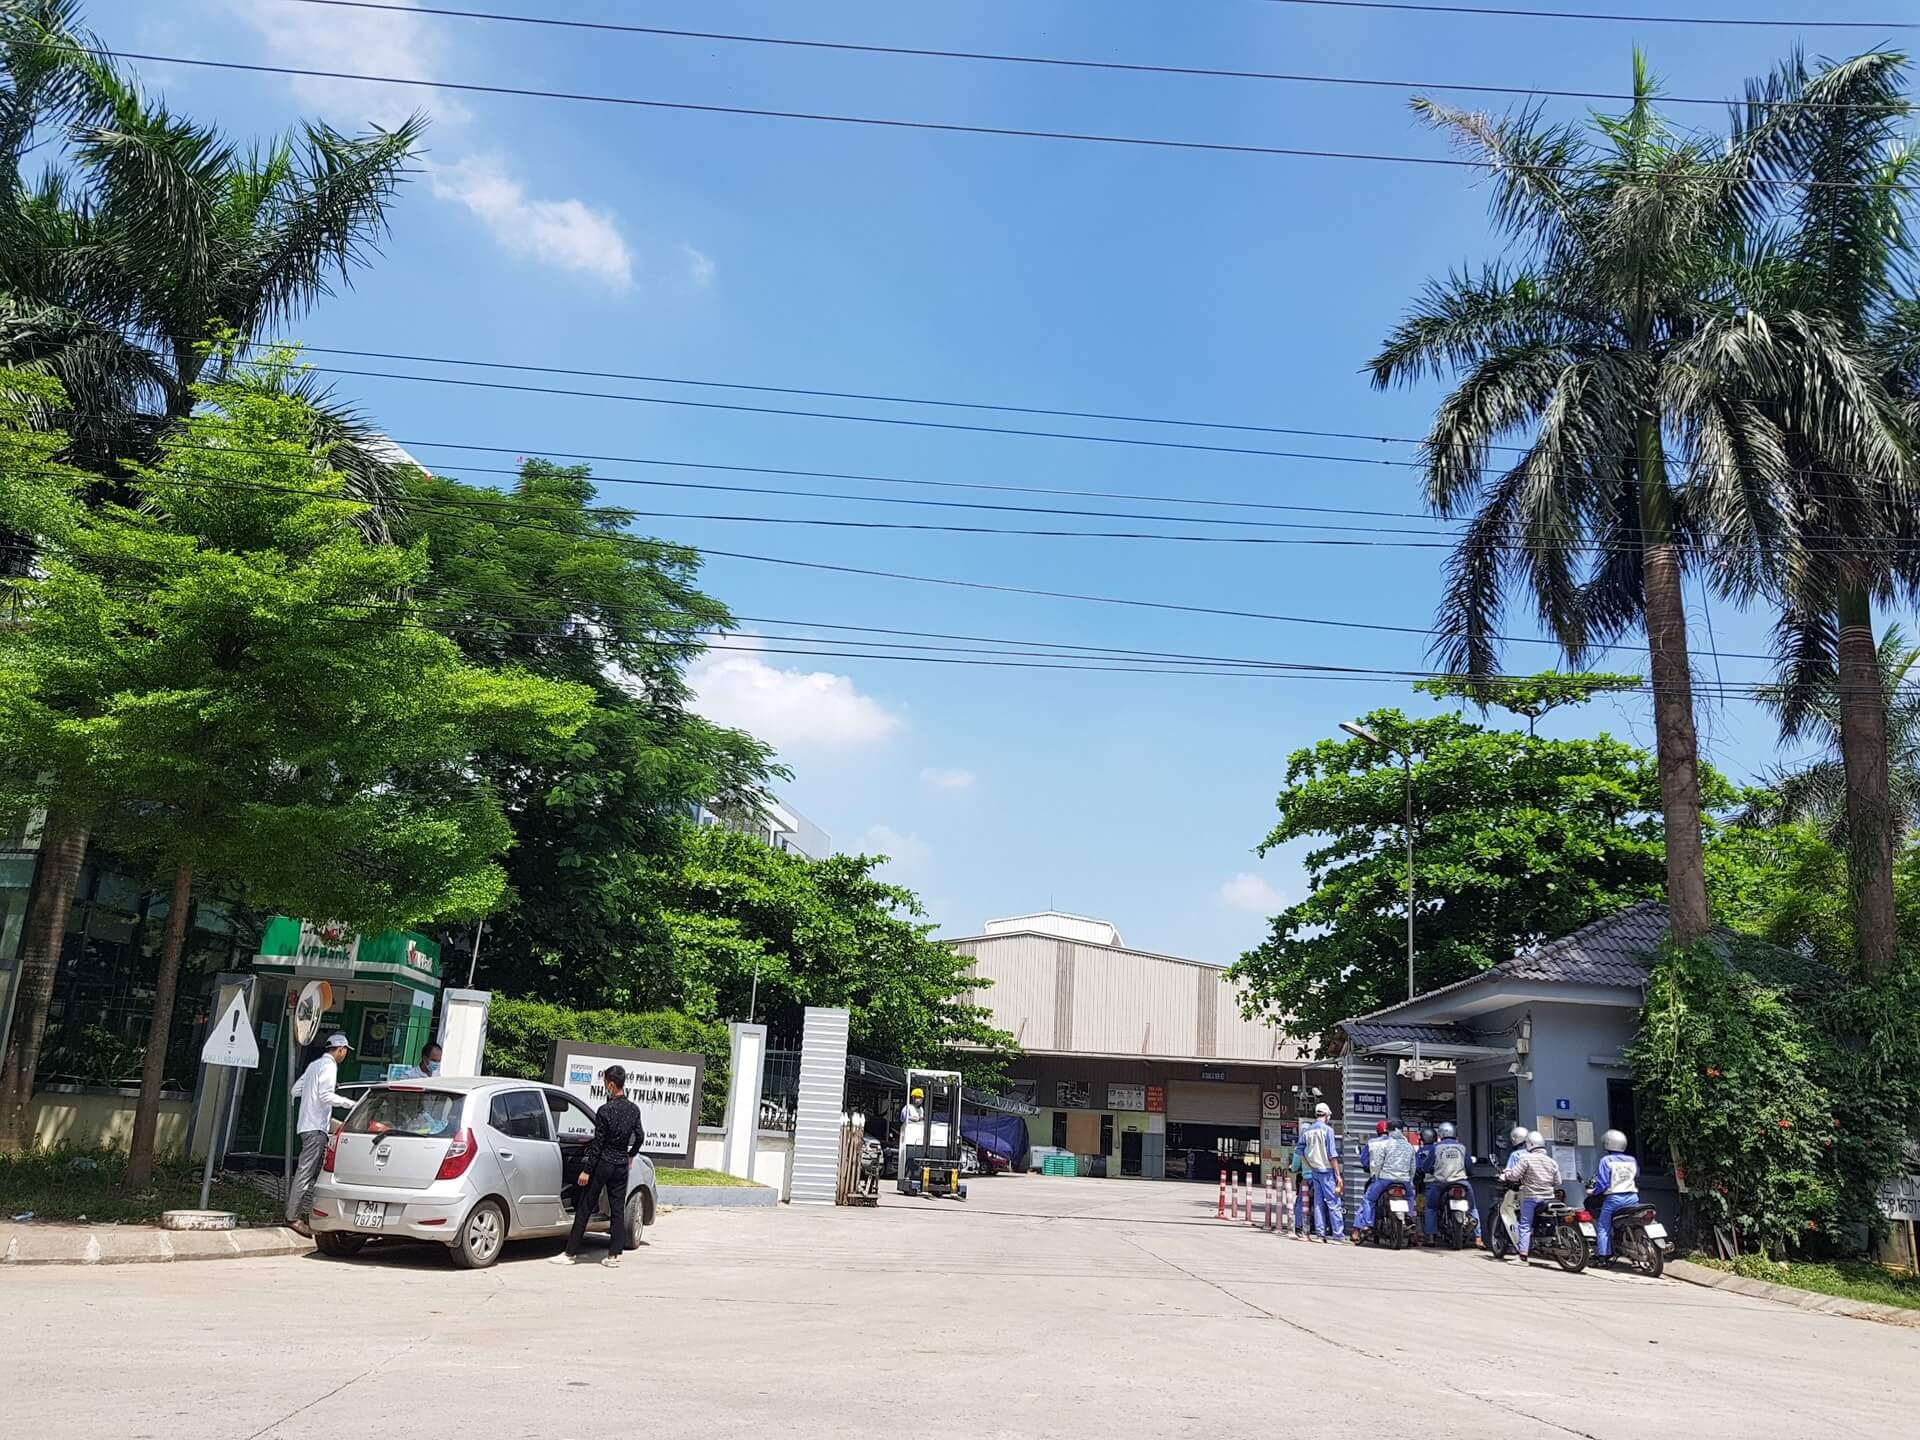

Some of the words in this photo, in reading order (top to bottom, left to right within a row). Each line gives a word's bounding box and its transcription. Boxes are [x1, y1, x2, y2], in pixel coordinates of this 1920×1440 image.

[590, 1085, 608, 1099] NH
[1268, 1096, 1275, 1106] 5
[1560, 1100, 1566, 1108] 6
